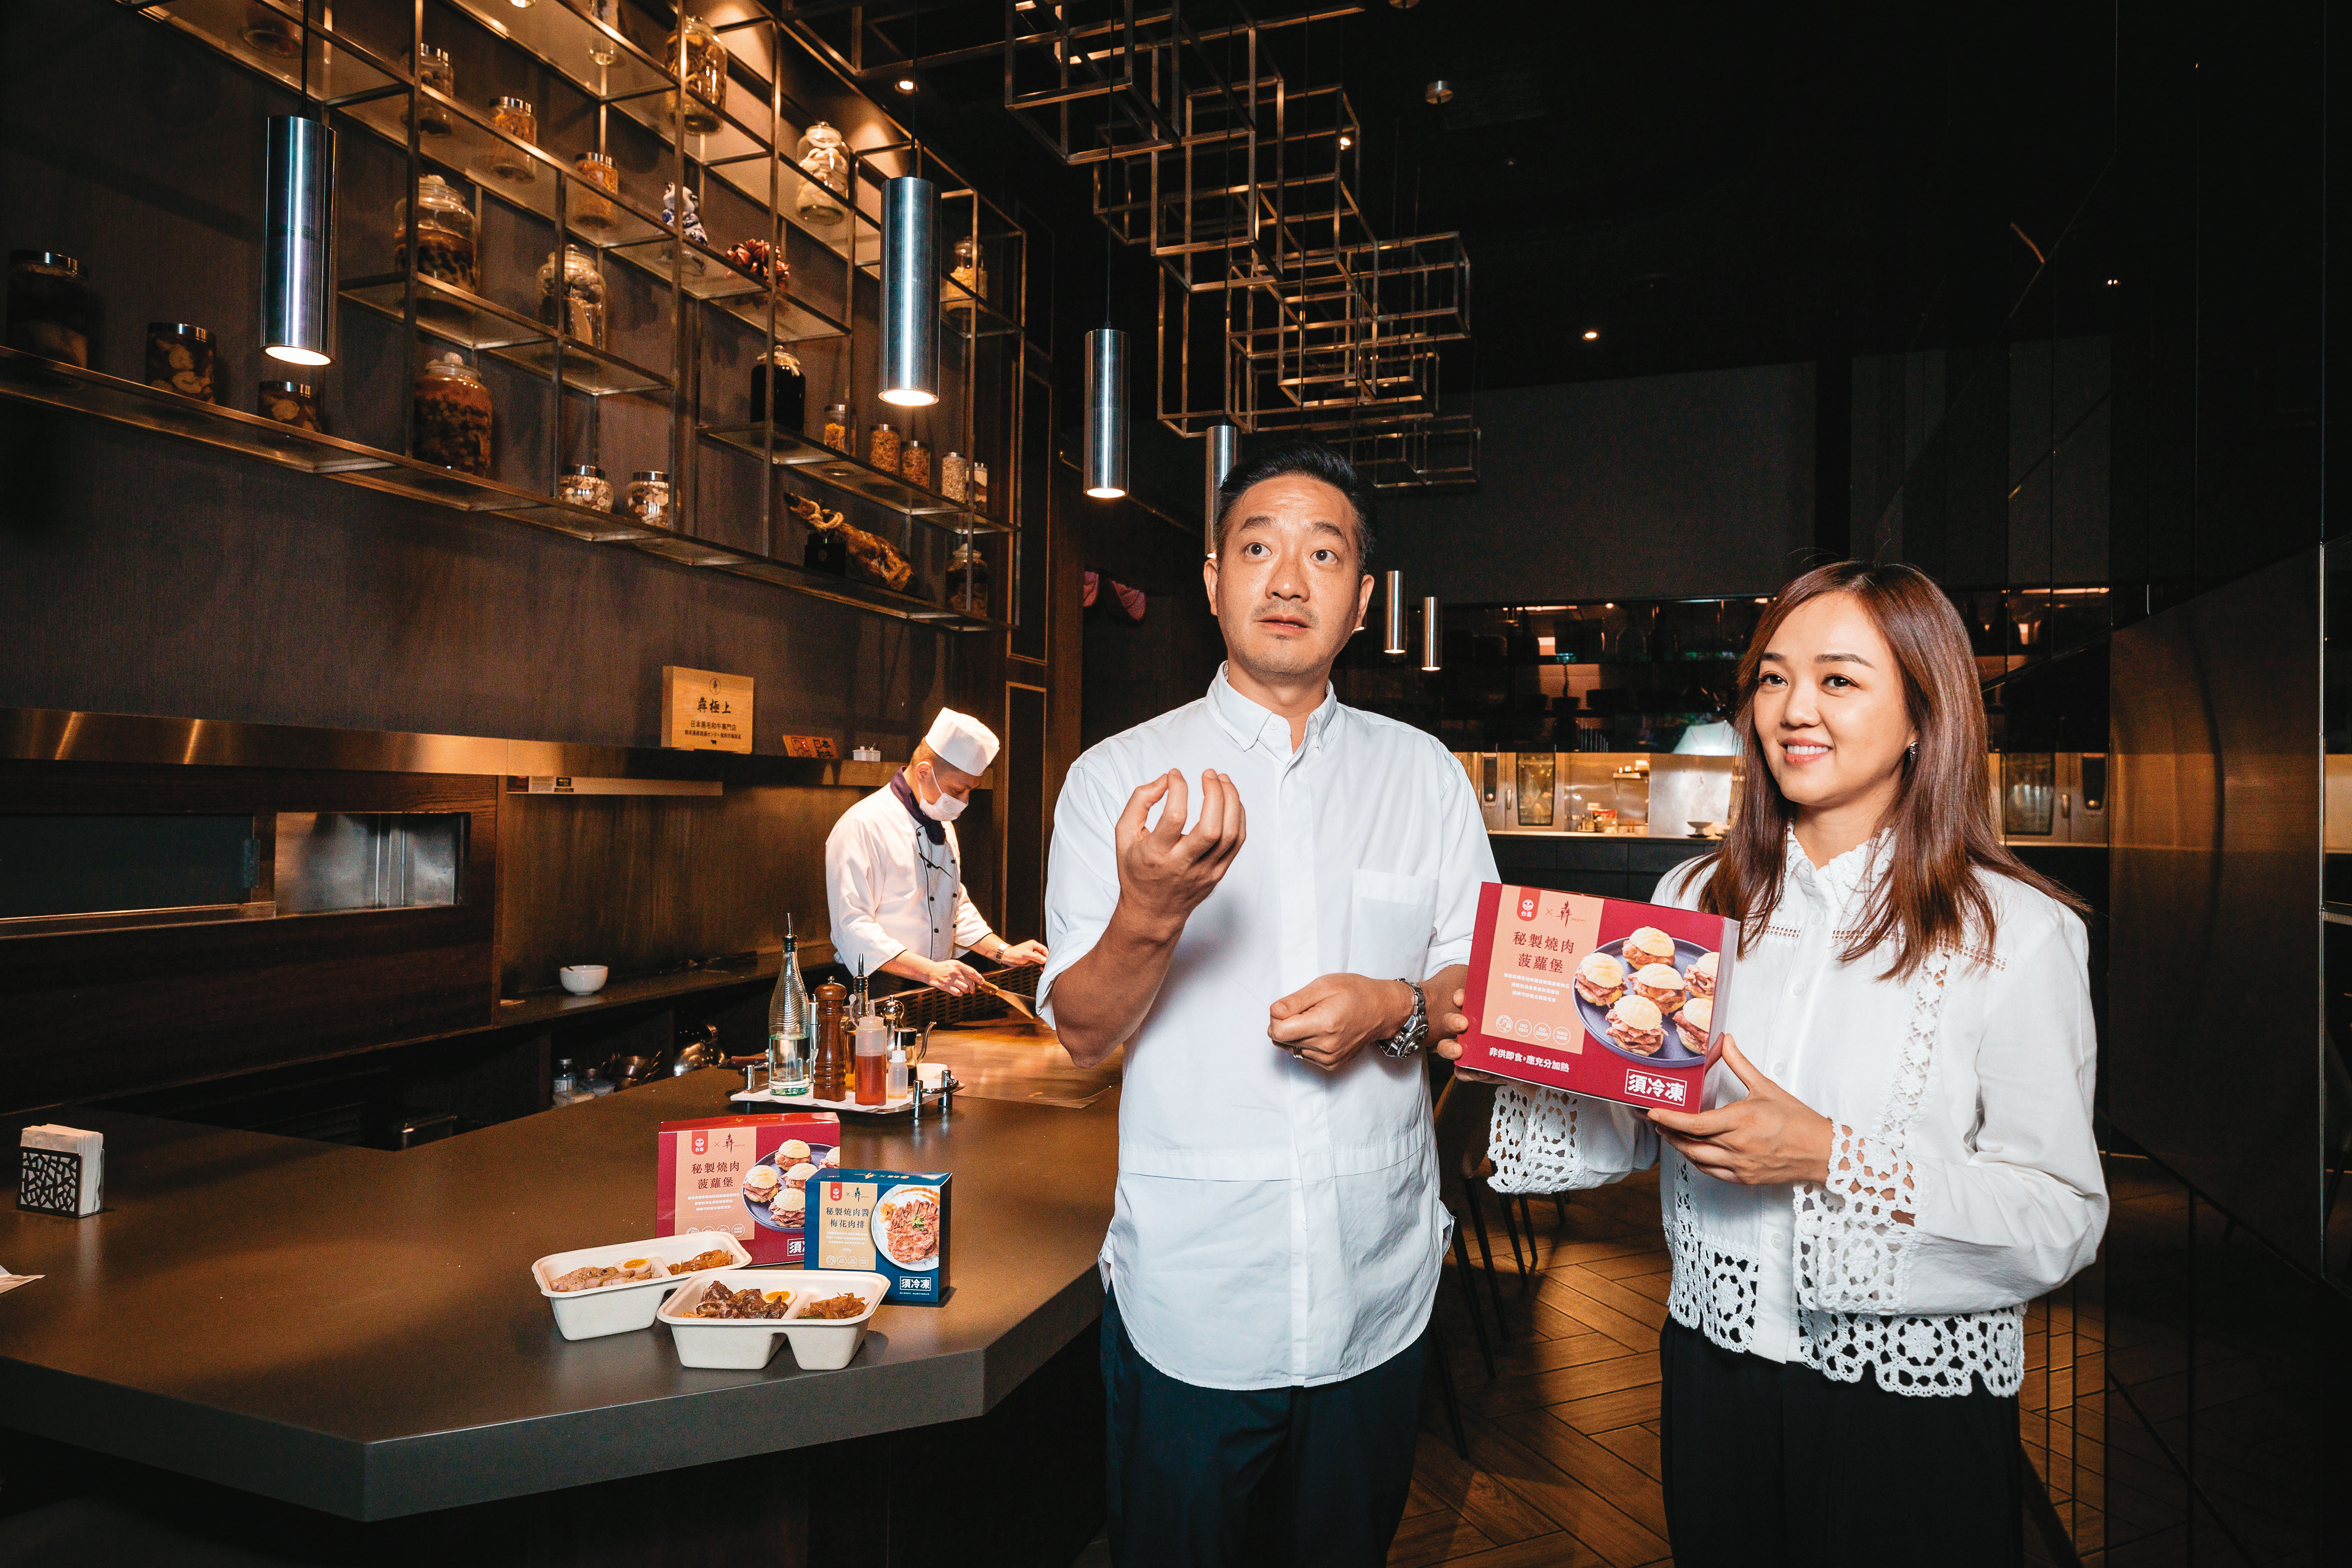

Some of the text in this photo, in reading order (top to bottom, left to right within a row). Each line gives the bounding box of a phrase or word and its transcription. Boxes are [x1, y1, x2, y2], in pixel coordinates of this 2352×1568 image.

[1512, 931, 1575, 954] 秘製燒肉
[1518, 953, 1563, 974] 菠蘿堡
[1628, 1073, 1684, 1102] 須冷凍
[691, 1161, 740, 1174] 秘製燒肉
[698, 1177, 734, 1189] 菠蘿堡
[826, 1206, 870, 1218] 秘製燒肉醬
[830, 1219, 865, 1229] 梅花肉排
[901, 1278, 930, 1289] 須冷凍
